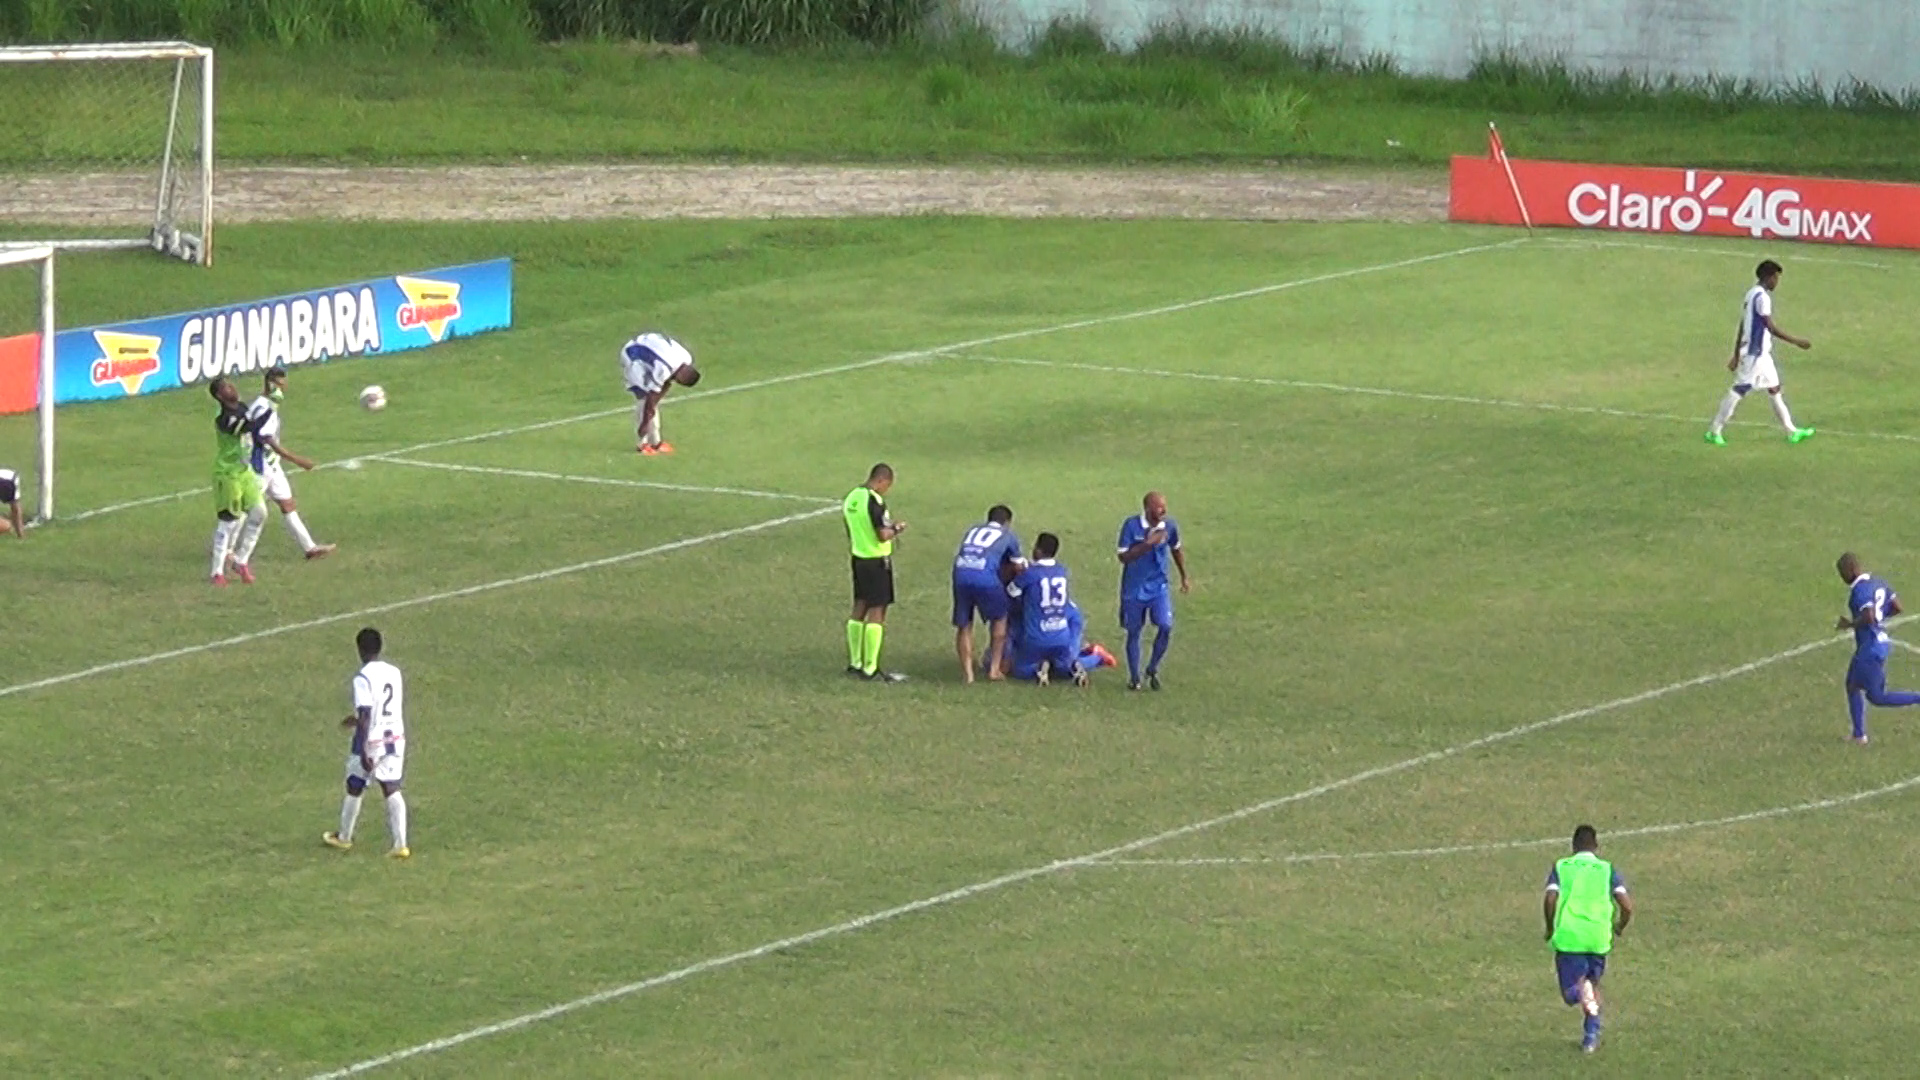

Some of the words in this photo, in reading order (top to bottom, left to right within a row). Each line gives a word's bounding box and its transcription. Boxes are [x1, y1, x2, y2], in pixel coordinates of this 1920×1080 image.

[1568, 182, 1703, 232] Claro
[179, 287, 380, 384] GUANABARA
[963, 526, 1003, 548] 10
[1040, 577, 1067, 608] 13
[382, 683, 393, 716] 2
